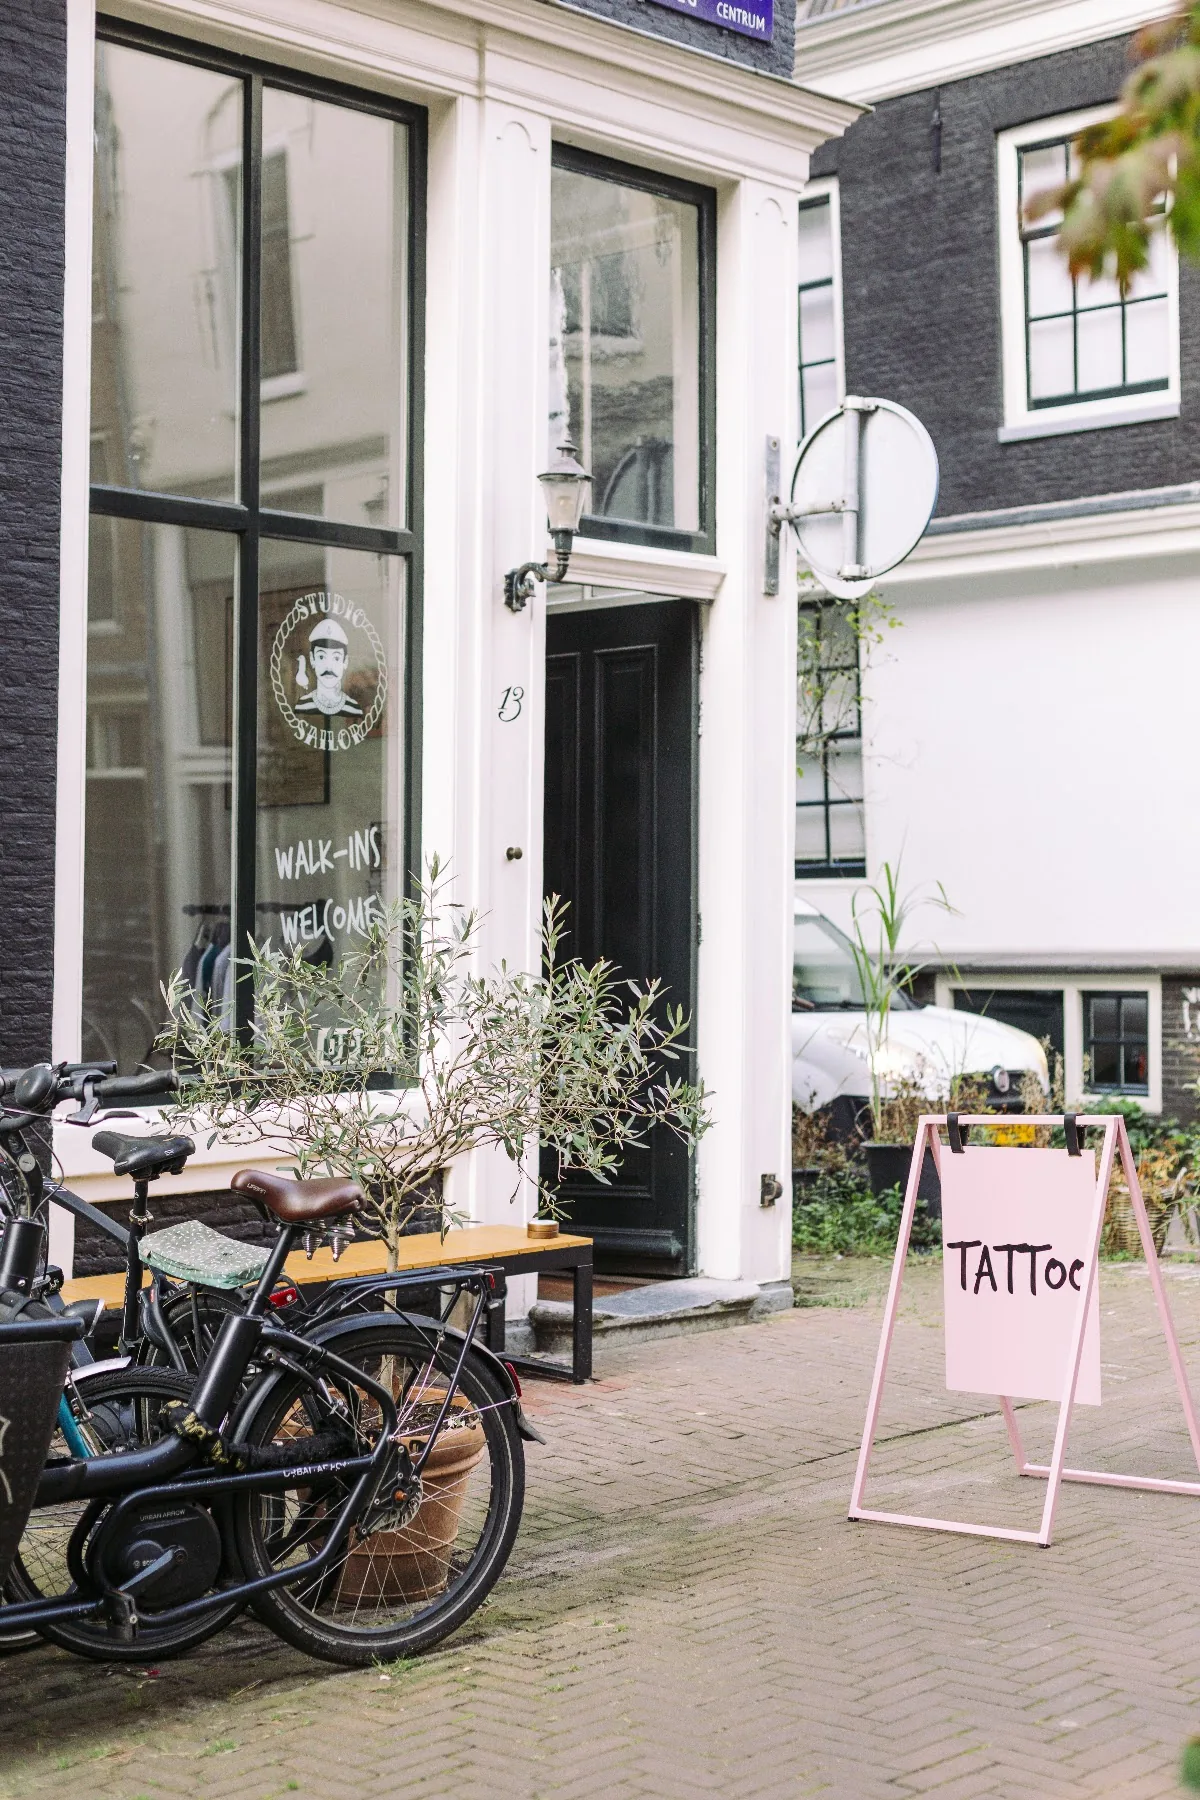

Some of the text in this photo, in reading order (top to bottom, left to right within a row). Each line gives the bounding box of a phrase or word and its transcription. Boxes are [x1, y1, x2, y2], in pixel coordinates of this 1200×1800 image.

[716, 2, 766, 31] CENTRUM
[295, 591, 365, 628] STUDIO
[497, 686, 524, 722] 13
[294, 719, 365, 750] SAILOR
[275, 826, 380, 879] WALK-INS
[280, 895, 377, 944] WELCOME
[322, 1033, 384, 1062] OPE
[163, 1508, 186, 1518] ARROW
